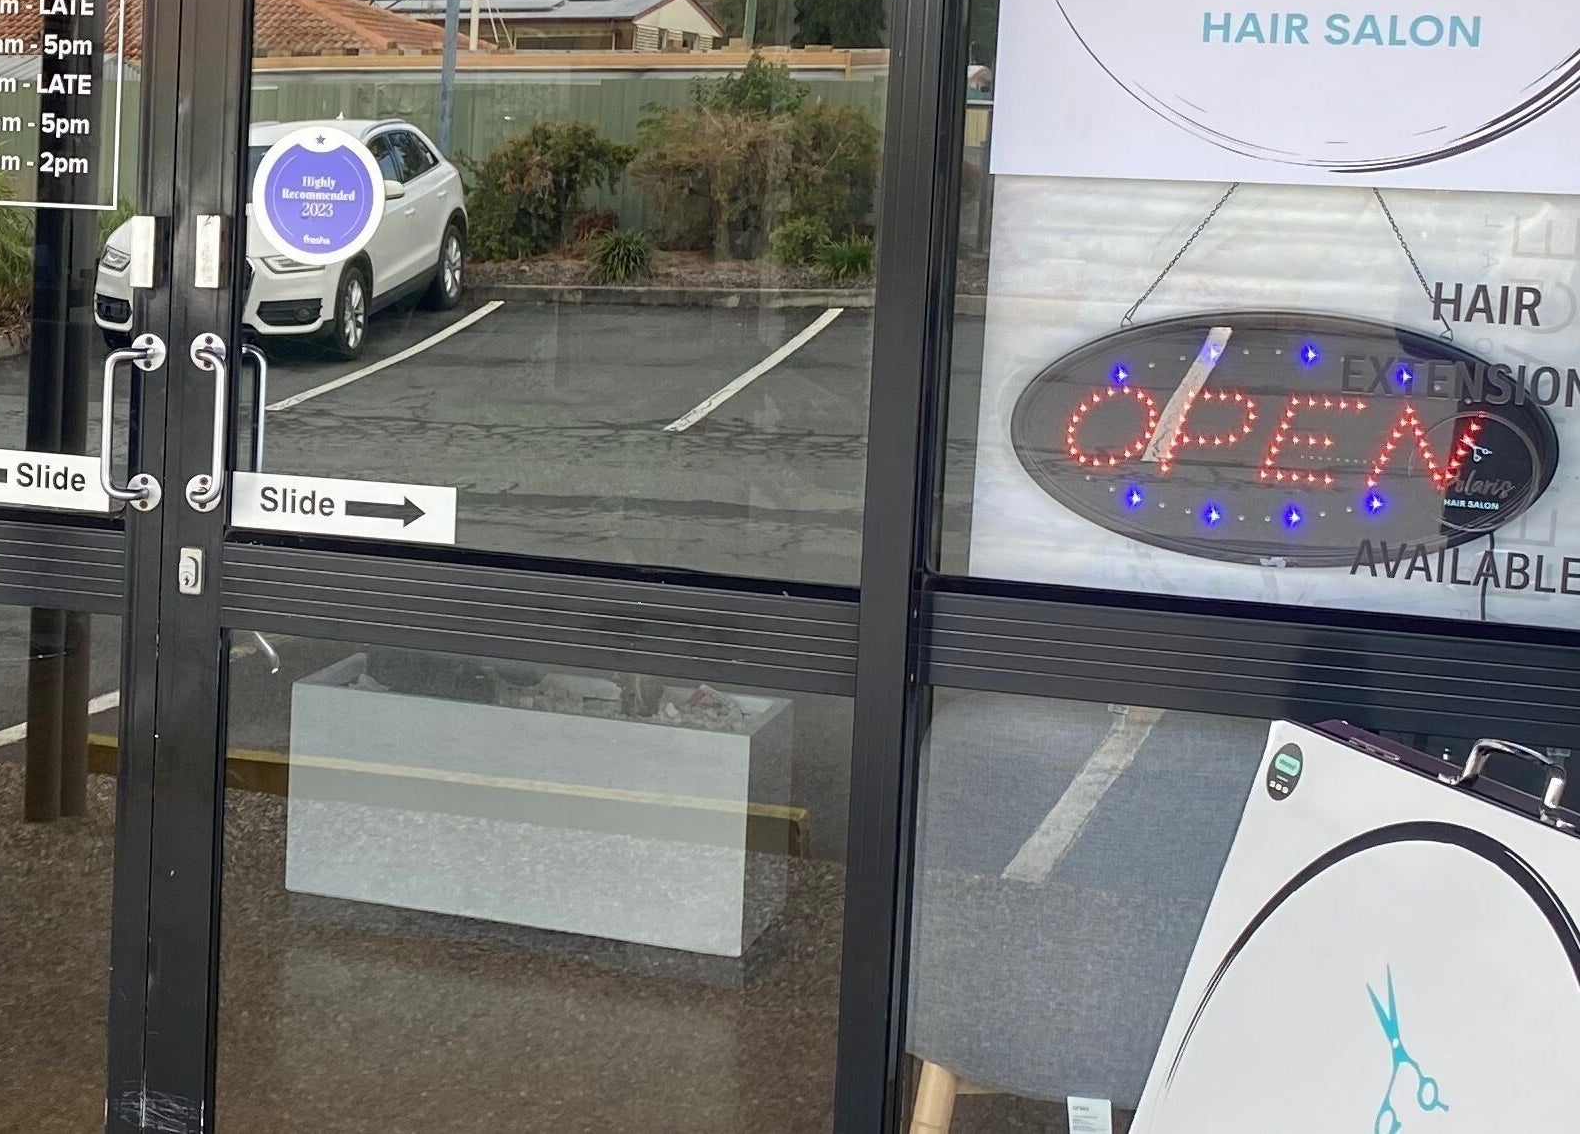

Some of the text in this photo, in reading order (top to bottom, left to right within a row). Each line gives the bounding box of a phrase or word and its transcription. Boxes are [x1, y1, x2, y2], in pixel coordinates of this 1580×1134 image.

[1202, 11, 1481, 48] HAIR SALON
[44, 34, 93, 60] 5pm
[36, 74, 91, 96] LATE
[41, 113, 90, 138] 5pm
[39, 152, 88, 177] 2pm
[282, 189, 355, 201] Recommended
[302, 176, 336, 190] Highly
[301, 203, 333, 217] 2023
[1432, 281, 1542, 326] HAIR
[1065, 383, 1486, 491] OPEN
[15, 462, 87, 494] Slide
[259, 485, 336, 518] Slide
[1443, 498, 1499, 510] HAIR SALON
[1349, 539, 1580, 595] AVAILABLE
